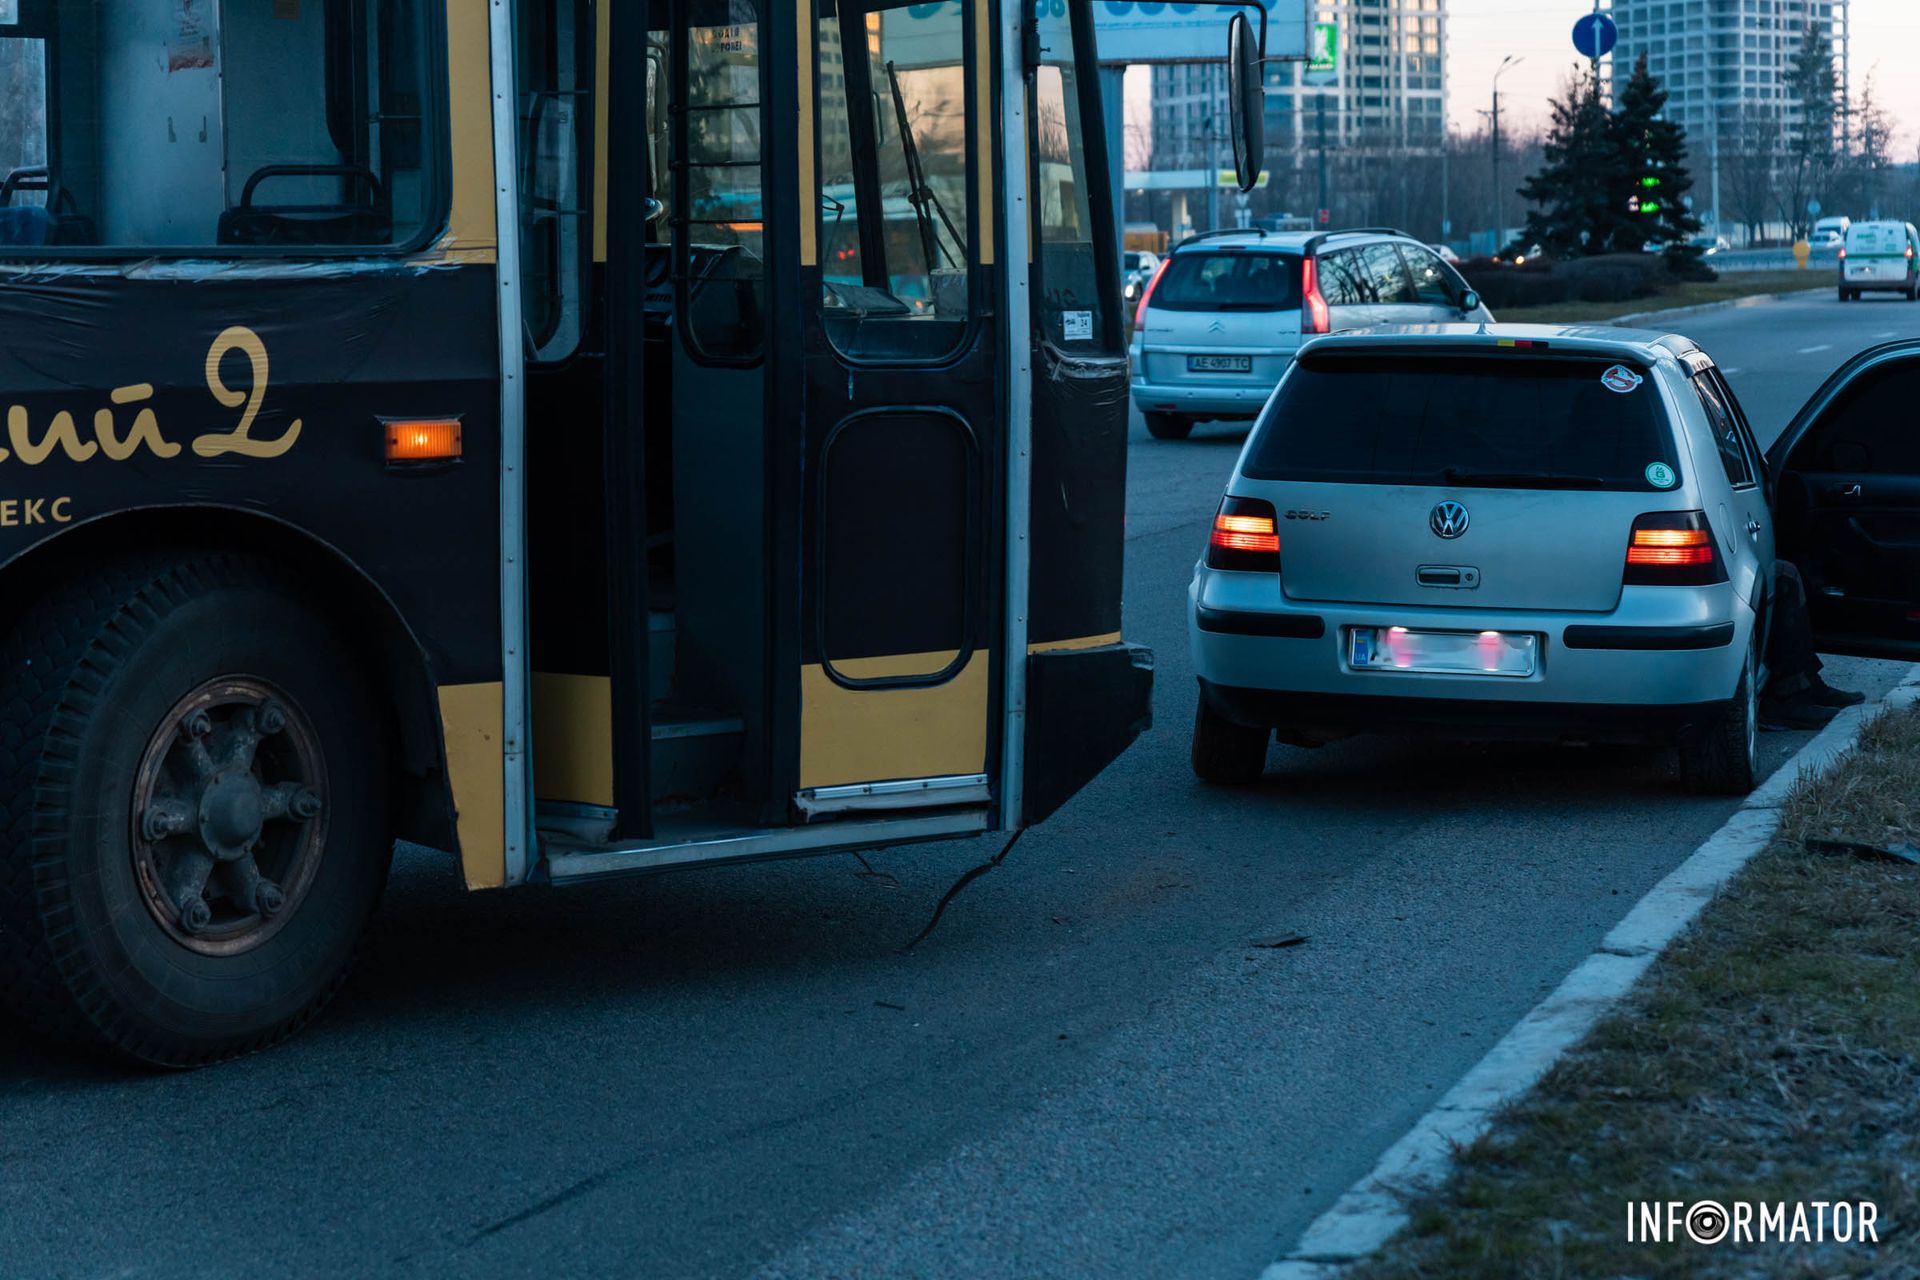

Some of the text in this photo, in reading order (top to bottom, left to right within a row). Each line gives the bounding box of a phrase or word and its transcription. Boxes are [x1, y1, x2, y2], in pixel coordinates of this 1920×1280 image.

[0, 325, 303, 465] ий 2
[1284, 509, 1331, 521] GOLF
[1355, 654, 1367, 662] UA
